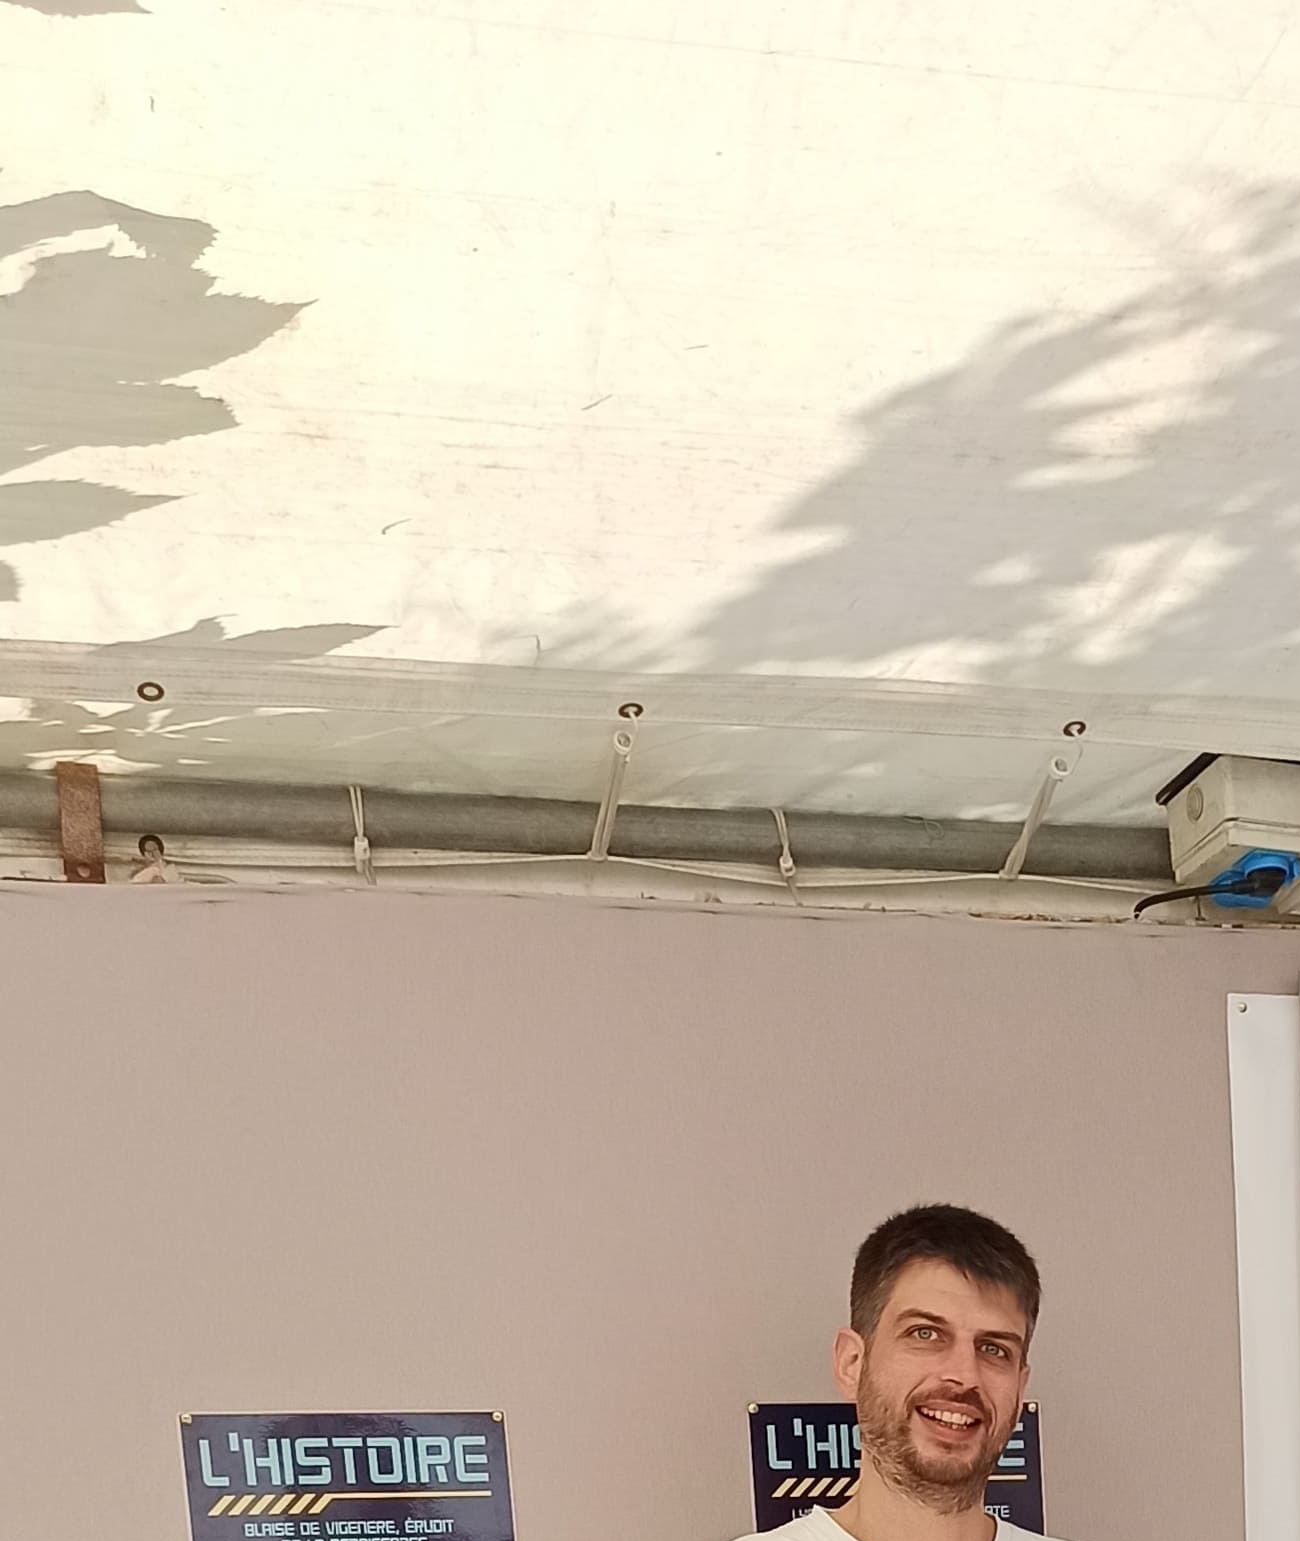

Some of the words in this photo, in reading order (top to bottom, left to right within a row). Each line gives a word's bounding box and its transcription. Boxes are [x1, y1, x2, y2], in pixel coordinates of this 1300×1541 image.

[199, 1432, 489, 1487] L'HISTOIRE
[244, 1523, 295, 1536] BLAISE
[301, 1522, 320, 1535] DE
[405, 1517, 454, 1533] ÉRUDIT
